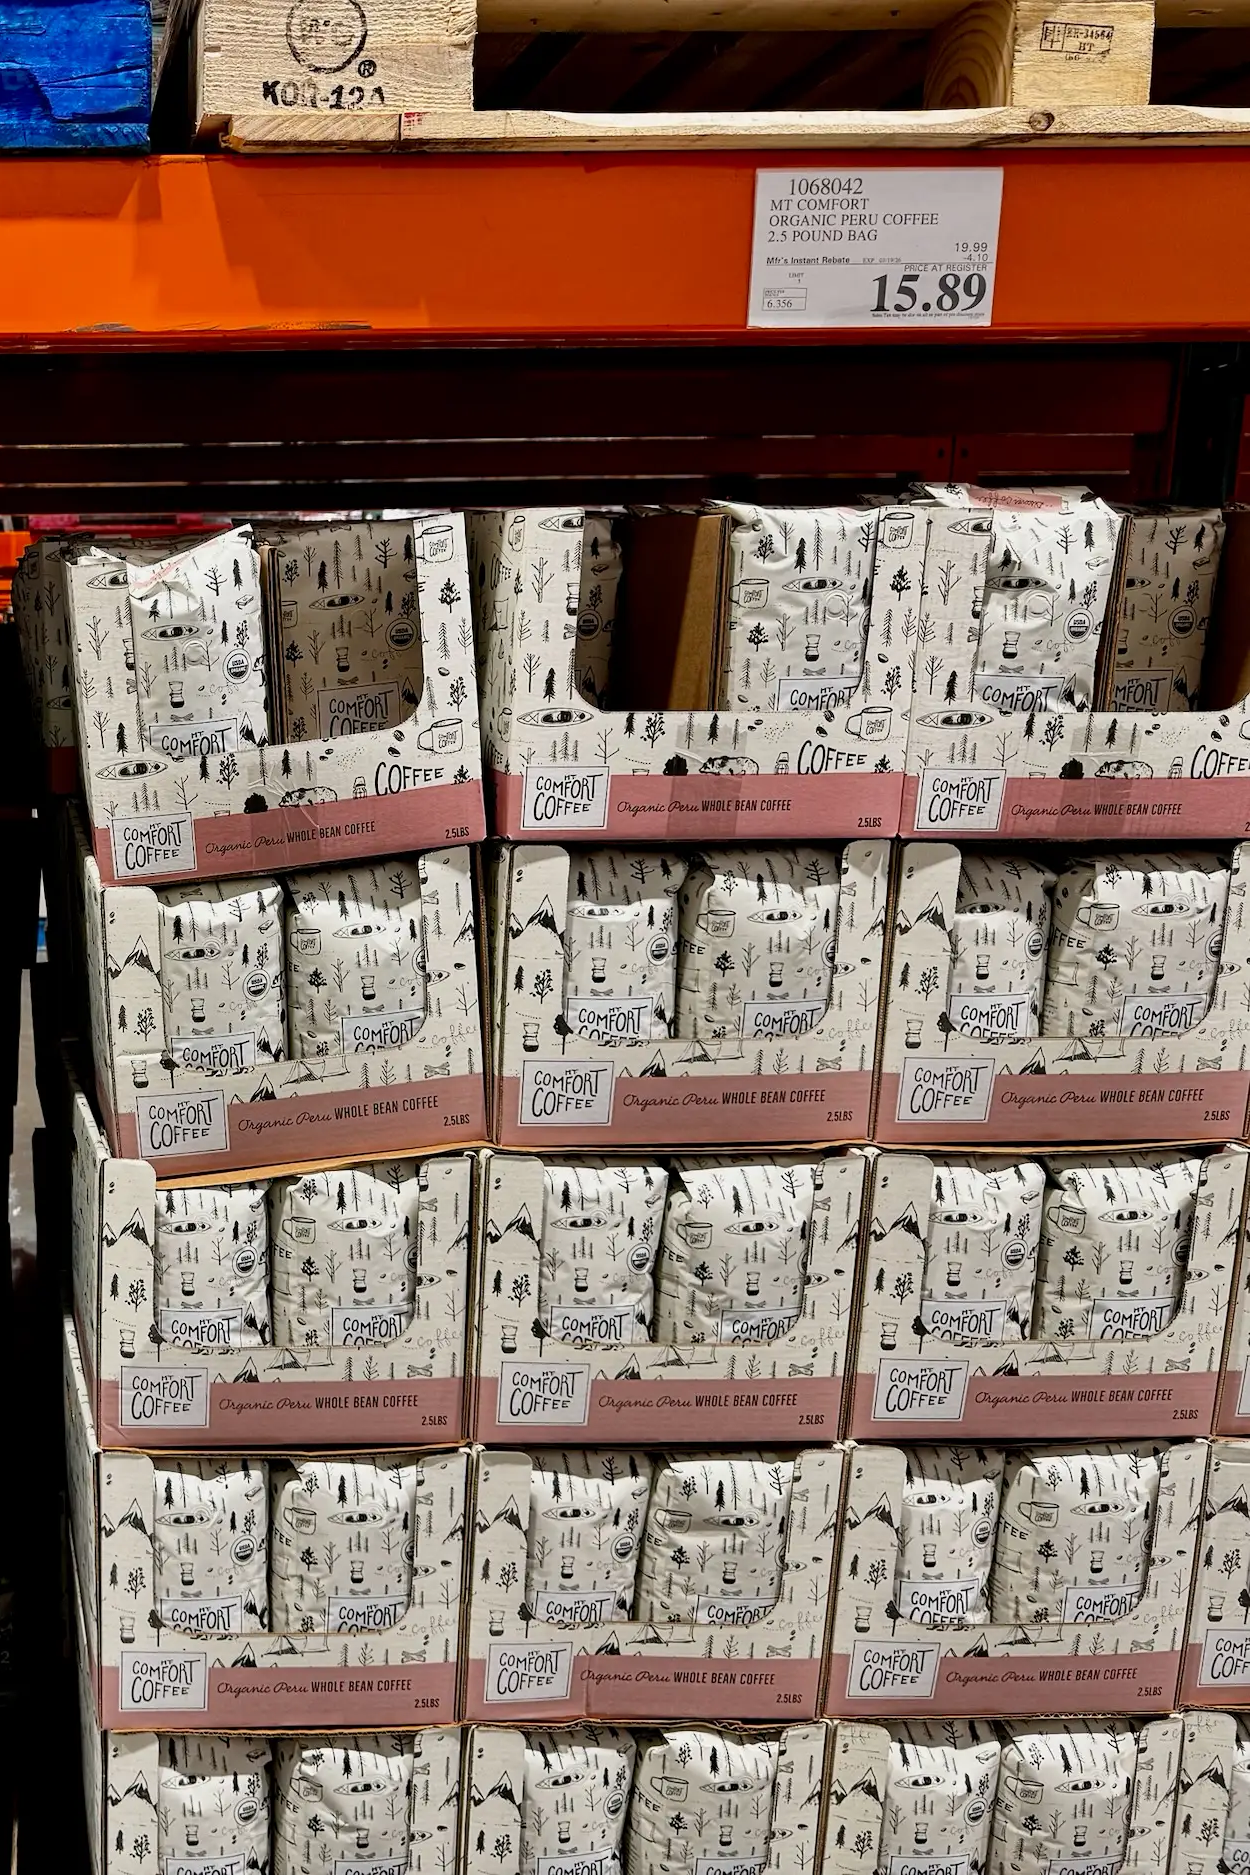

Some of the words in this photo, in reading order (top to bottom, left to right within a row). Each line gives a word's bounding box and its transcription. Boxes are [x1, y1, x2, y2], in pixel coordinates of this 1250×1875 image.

[789, 178, 863, 195] 1068042
[771, 200, 792, 211] MT
[797, 198, 869, 210] COMFORT
[770, 215, 836, 226] ORGANIC
[841, 214, 878, 225] PERU
[883, 214, 939, 225] COFFEE
[768, 231, 787, 242] 2.5
[792, 230, 843, 242] POUND
[848, 230, 878, 241] BAG
[954, 243, 988, 252] 19.99
[963, 254, 988, 262] -4.10
[947, 264, 987, 272] REGISTER
[870, 273, 986, 312] 15.89
[767, 300, 792, 308] 6.356
[329, 691, 393, 718] COMFORT
[161, 729, 231, 755] COMFORT
[375, 763, 444, 796] COFFEE
[537, 775, 602, 801] COMFORT
[533, 793, 591, 821] COFFEE
[617, 801, 665, 818] Organic
[668, 799, 699, 813] Peru
[701, 801, 731, 813] WHOLE
[734, 801, 757, 812] BEAN
[760, 799, 791, 812] COFFEE
[124, 820, 186, 847] COMFORT
[446, 827, 470, 839] 2.5LBS
[857, 818, 881, 828] 2.5LBS
[205, 838, 251, 855] Organic
[255, 835, 284, 849] Peru
[286, 830, 317, 843] WHOLE
[320, 826, 341, 839] BEAN
[345, 820, 376, 837] COFFEE
[125, 844, 180, 871] COFFEE
[914, 1066, 987, 1094] COMFORT
[910, 1085, 973, 1113] COFFEE
[1001, 1092, 1057, 1108] Organic
[1059, 1091, 1096, 1103] Peru
[1100, 1090, 1135, 1103] WHOLE
[1138, 1090, 1165, 1102] BEAN
[1168, 1089, 1204, 1102] COFFEE
[1204, 1110, 1230, 1121] 2.5LBS
[132, 1375, 202, 1401] COMFORT
[131, 1396, 191, 1420] COFFEE
[219, 1399, 274, 1415] Organic
[276, 1398, 311, 1410] Peru
[315, 1397, 349, 1408] WHOLE
[353, 1396, 379, 1408] BEAN
[383, 1395, 418, 1407] COFFEE
[421, 1415, 447, 1426] 2.5LBS
[499, 1649, 566, 1675] COMFORT
[864, 1649, 934, 1674] COMFORT
[497, 1670, 554, 1695] COFFEE
[860, 1669, 919, 1691] COFFEE
[947, 1670, 999, 1685] Organic
[1002, 1671, 1035, 1682] Peru
[1039, 1670, 1073, 1682] WHOLE
[1076, 1669, 1101, 1681] BEAN
[1104, 1668, 1137, 1680] COFFEE
[1137, 1687, 1162, 1696] 2.5LBS
